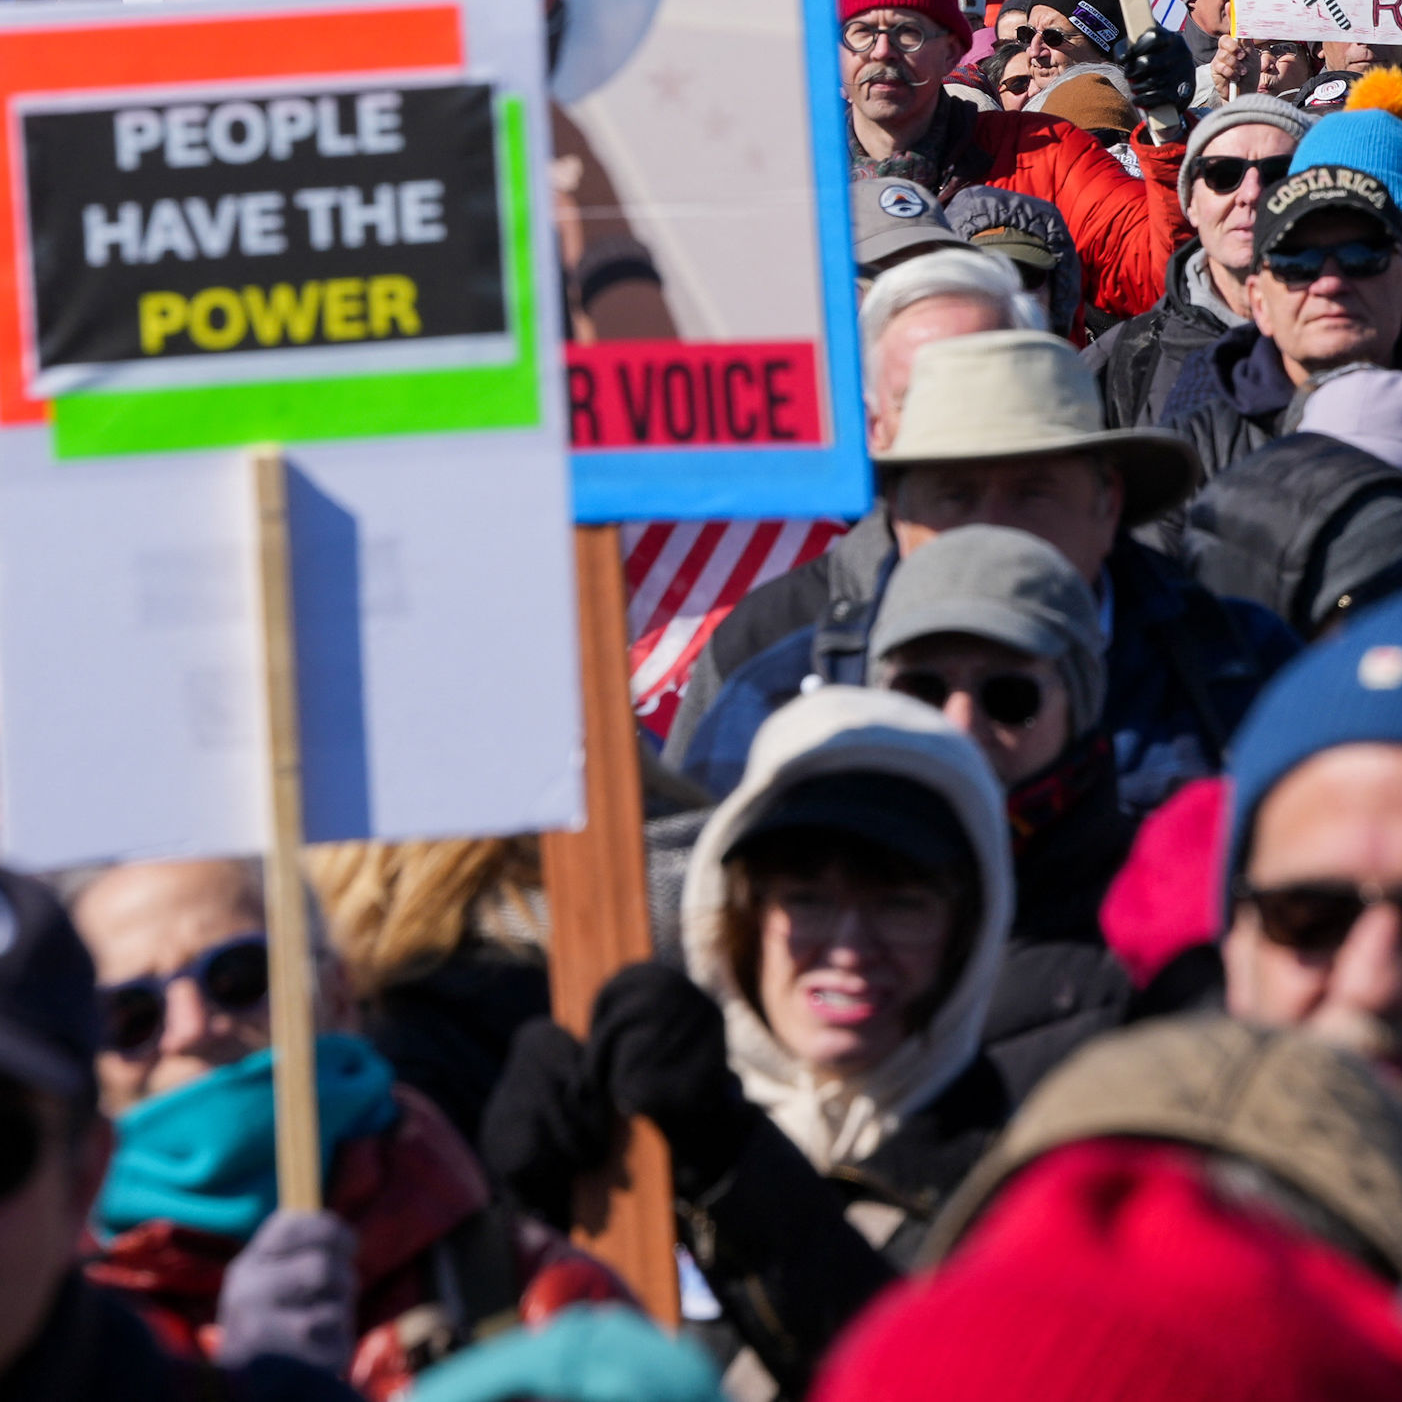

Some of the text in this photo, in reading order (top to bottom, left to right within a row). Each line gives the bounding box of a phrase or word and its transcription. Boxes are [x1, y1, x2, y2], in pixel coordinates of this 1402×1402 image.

[115, 91, 404, 171] PEOPLE
[84, 181, 447, 268] HAVE THE
[1266, 167, 1388, 215] COSTA RICA
[140, 276, 422, 357] POWER
[620, 357, 799, 444] VOICE
